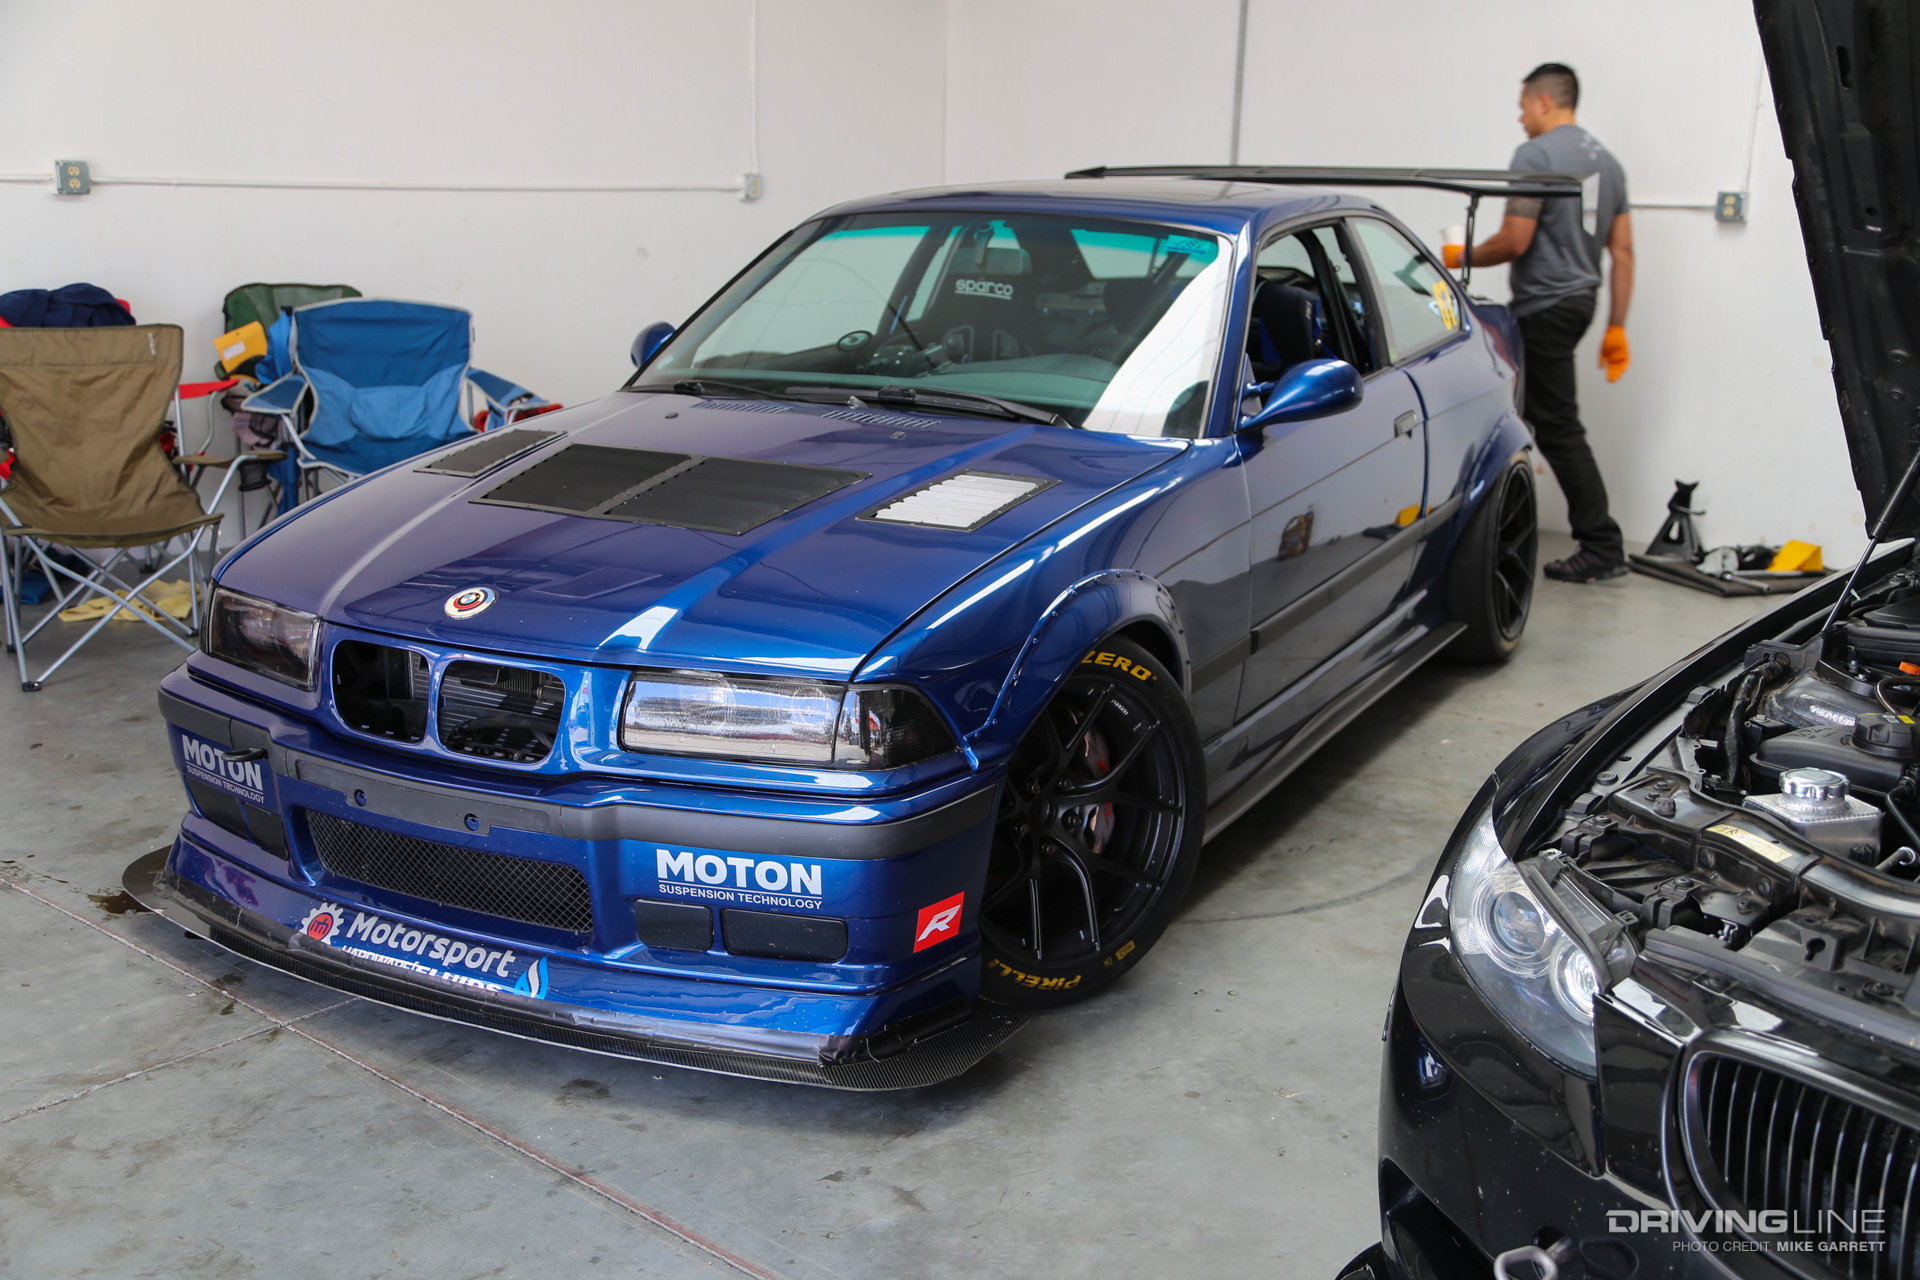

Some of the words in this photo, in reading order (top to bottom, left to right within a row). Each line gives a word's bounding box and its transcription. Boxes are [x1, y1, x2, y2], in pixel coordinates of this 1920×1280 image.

[955, 279, 1014, 296] sparco
[1081, 650, 1152, 681] ZERO
[182, 734, 263, 791] MOTON
[186, 765, 222, 787] SUSPENSION
[222, 781, 265, 804] TECHNOLOGY
[656, 849, 823, 895] MOTON
[659, 884, 735, 901] SUSPENSION
[737, 893, 823, 910] TECHNOLOGY
[346, 912, 517, 977] Motorsport
[986, 958, 1082, 990] PIRELLI
